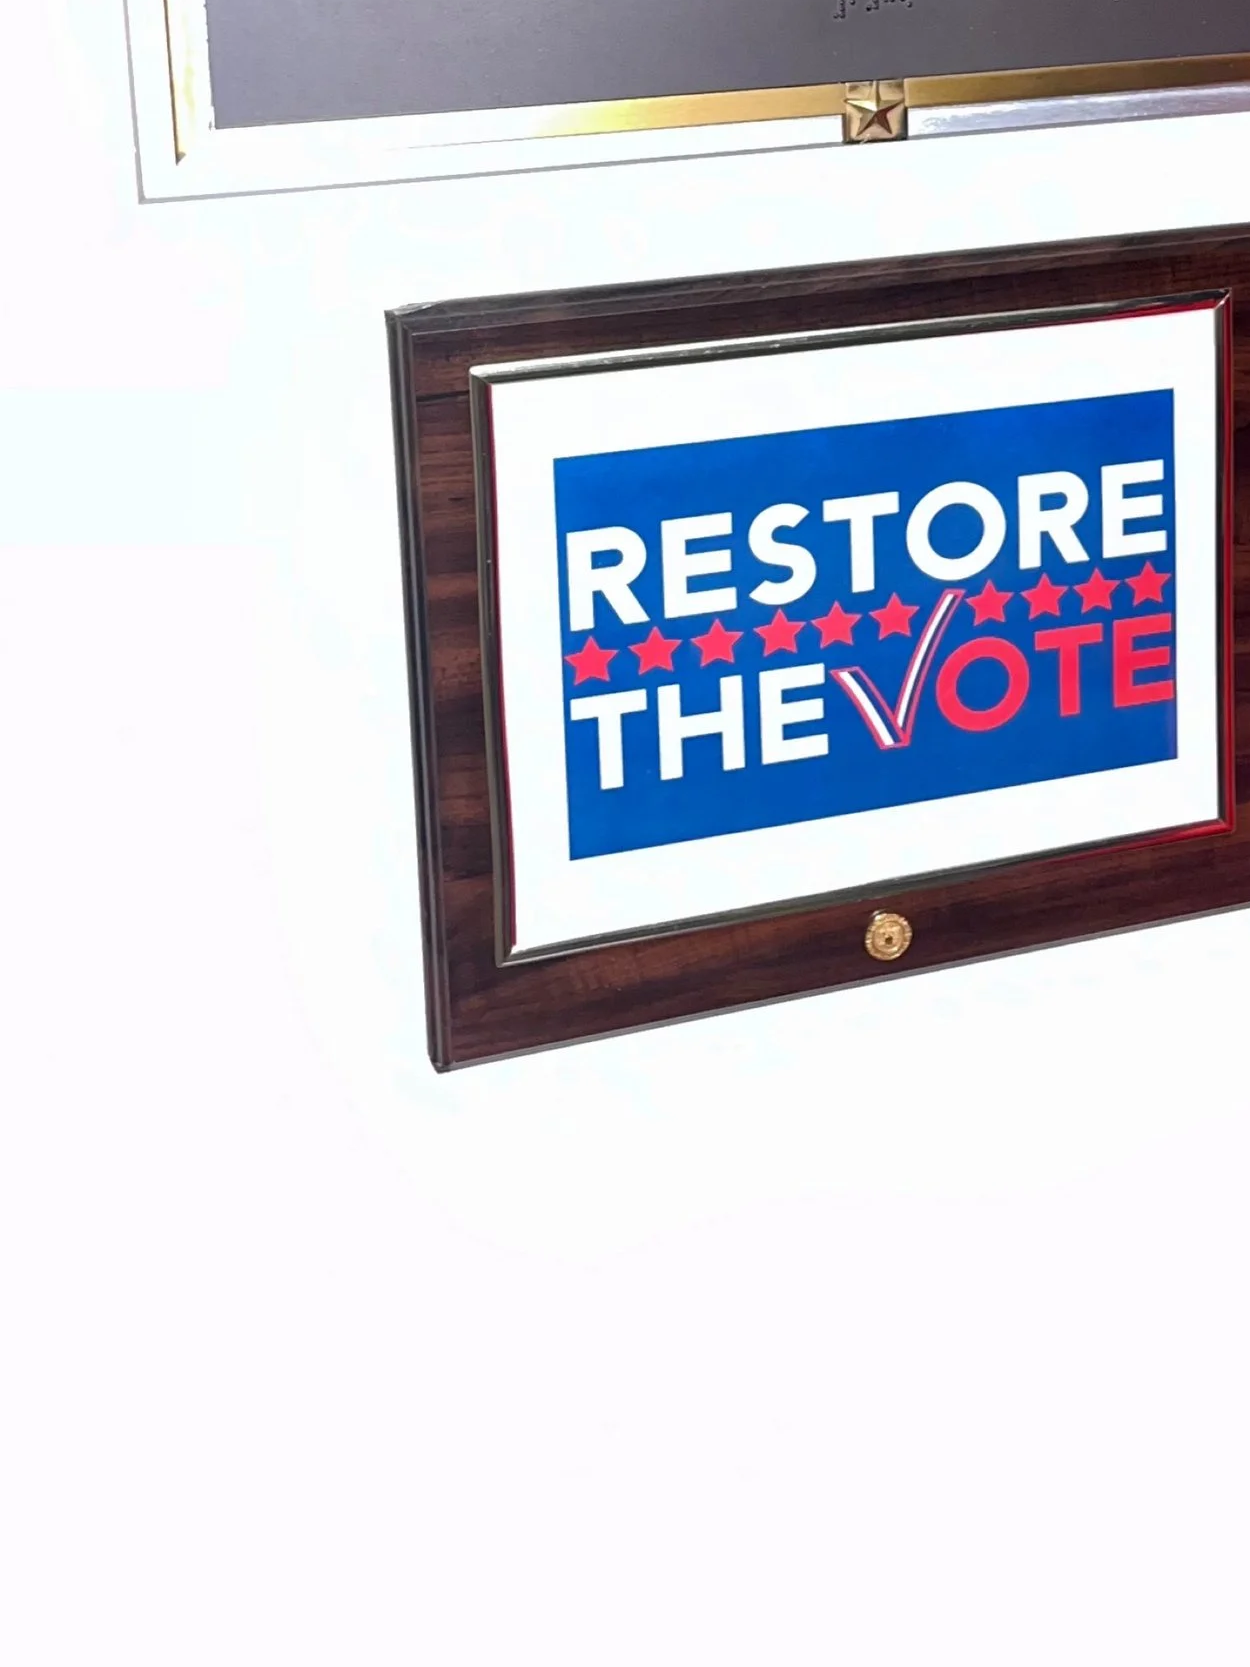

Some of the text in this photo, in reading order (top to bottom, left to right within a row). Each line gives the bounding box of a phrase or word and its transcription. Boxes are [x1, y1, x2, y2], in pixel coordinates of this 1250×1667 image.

[565, 458, 1168, 633] RESTORE
[569, 588, 1175, 791] THE VOTE
